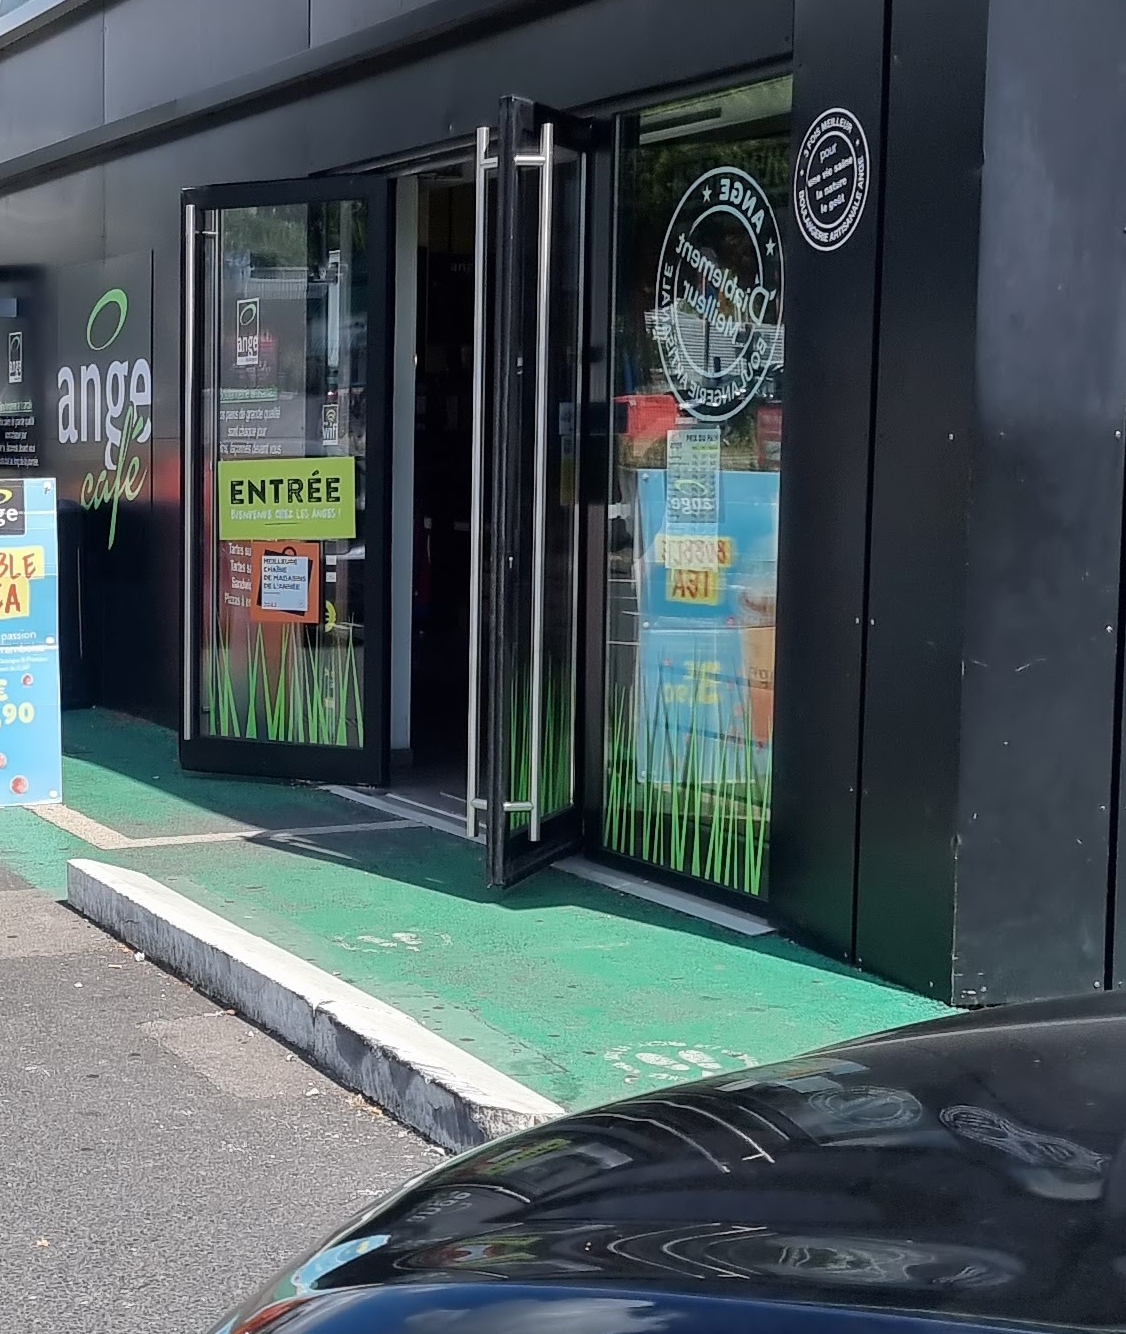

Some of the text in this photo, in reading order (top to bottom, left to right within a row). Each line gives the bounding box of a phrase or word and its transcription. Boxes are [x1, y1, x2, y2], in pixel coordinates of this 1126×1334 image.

[819, 142, 837, 163] pour
[857, 155, 865, 189] ANGE
[237, 336, 259, 357] ange
[58, 359, 151, 470] ange
[81, 406, 147, 550] café
[230, 470, 341, 505] ENTRÉE
[296, 508, 308, 519] LES
[1, 630, 37, 644] passion
